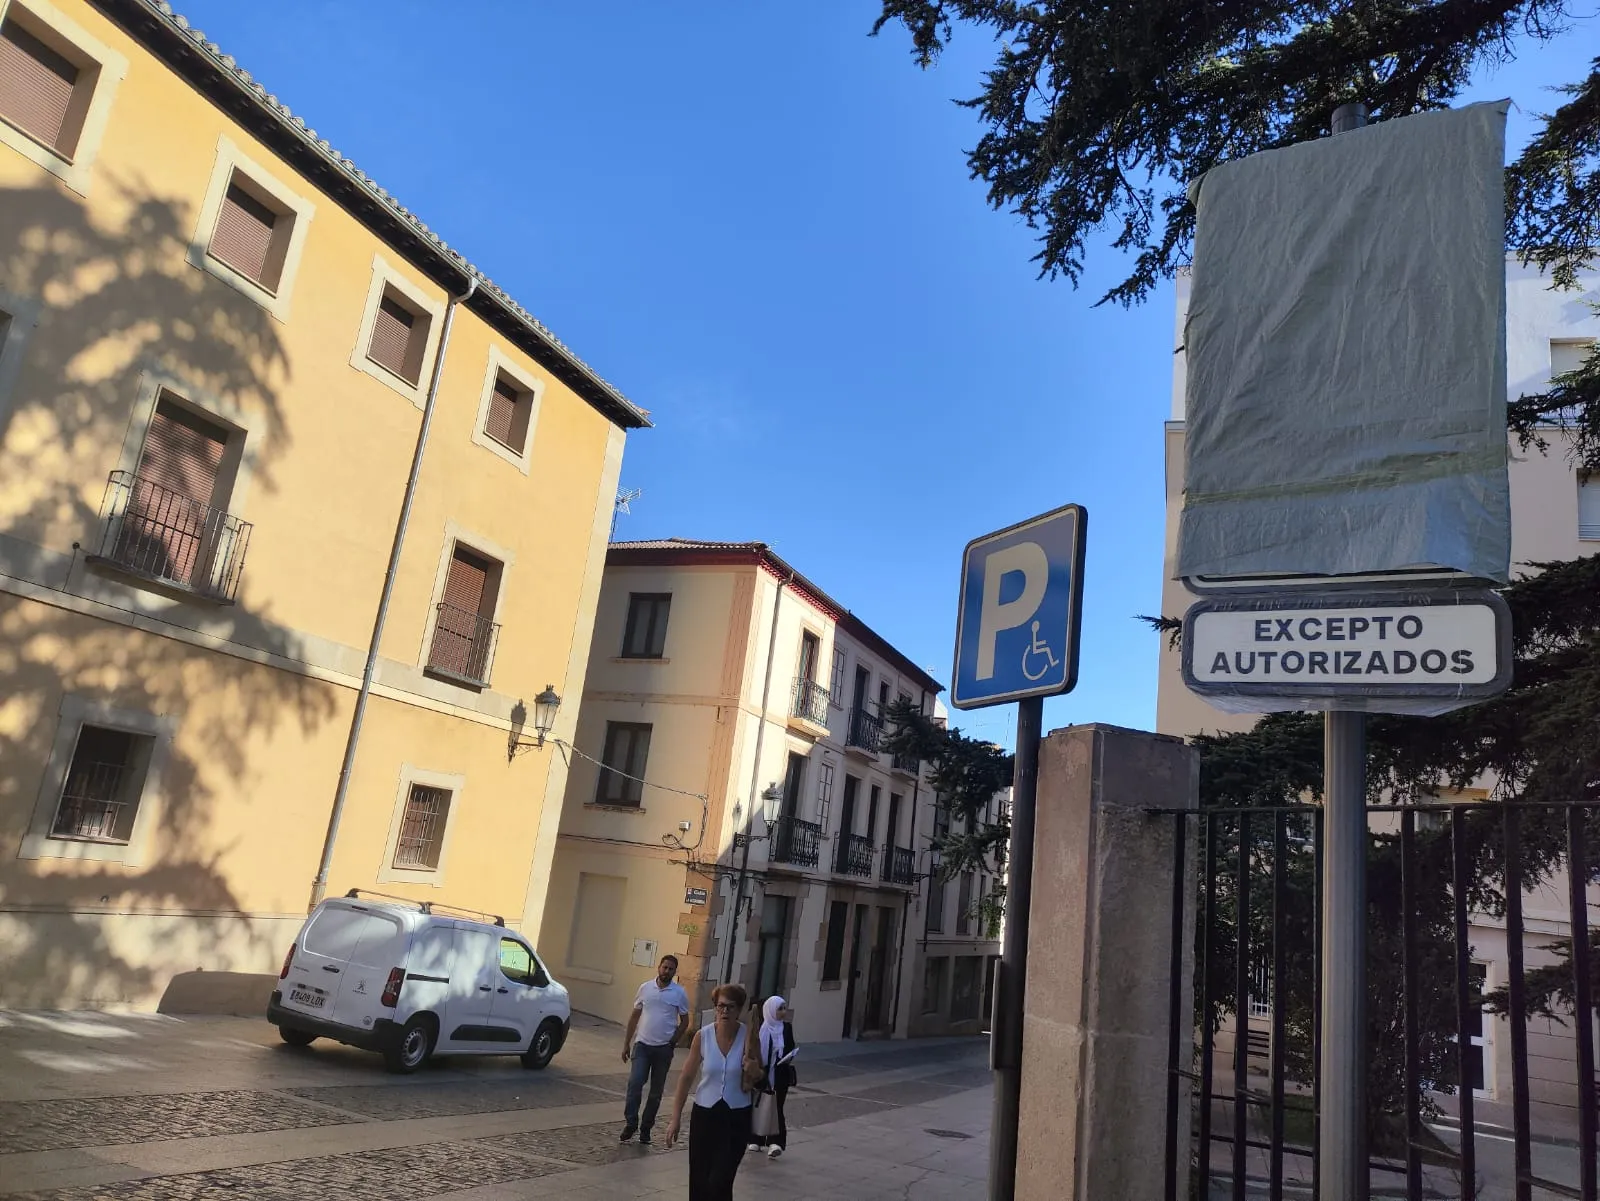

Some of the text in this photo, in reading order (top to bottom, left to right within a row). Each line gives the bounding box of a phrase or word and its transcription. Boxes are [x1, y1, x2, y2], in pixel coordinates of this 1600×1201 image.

[975, 541, 1049, 682] P
[1254, 614, 1423, 642] EXCEPTO
[1209, 648, 1475, 675] AUTORIZADOS
